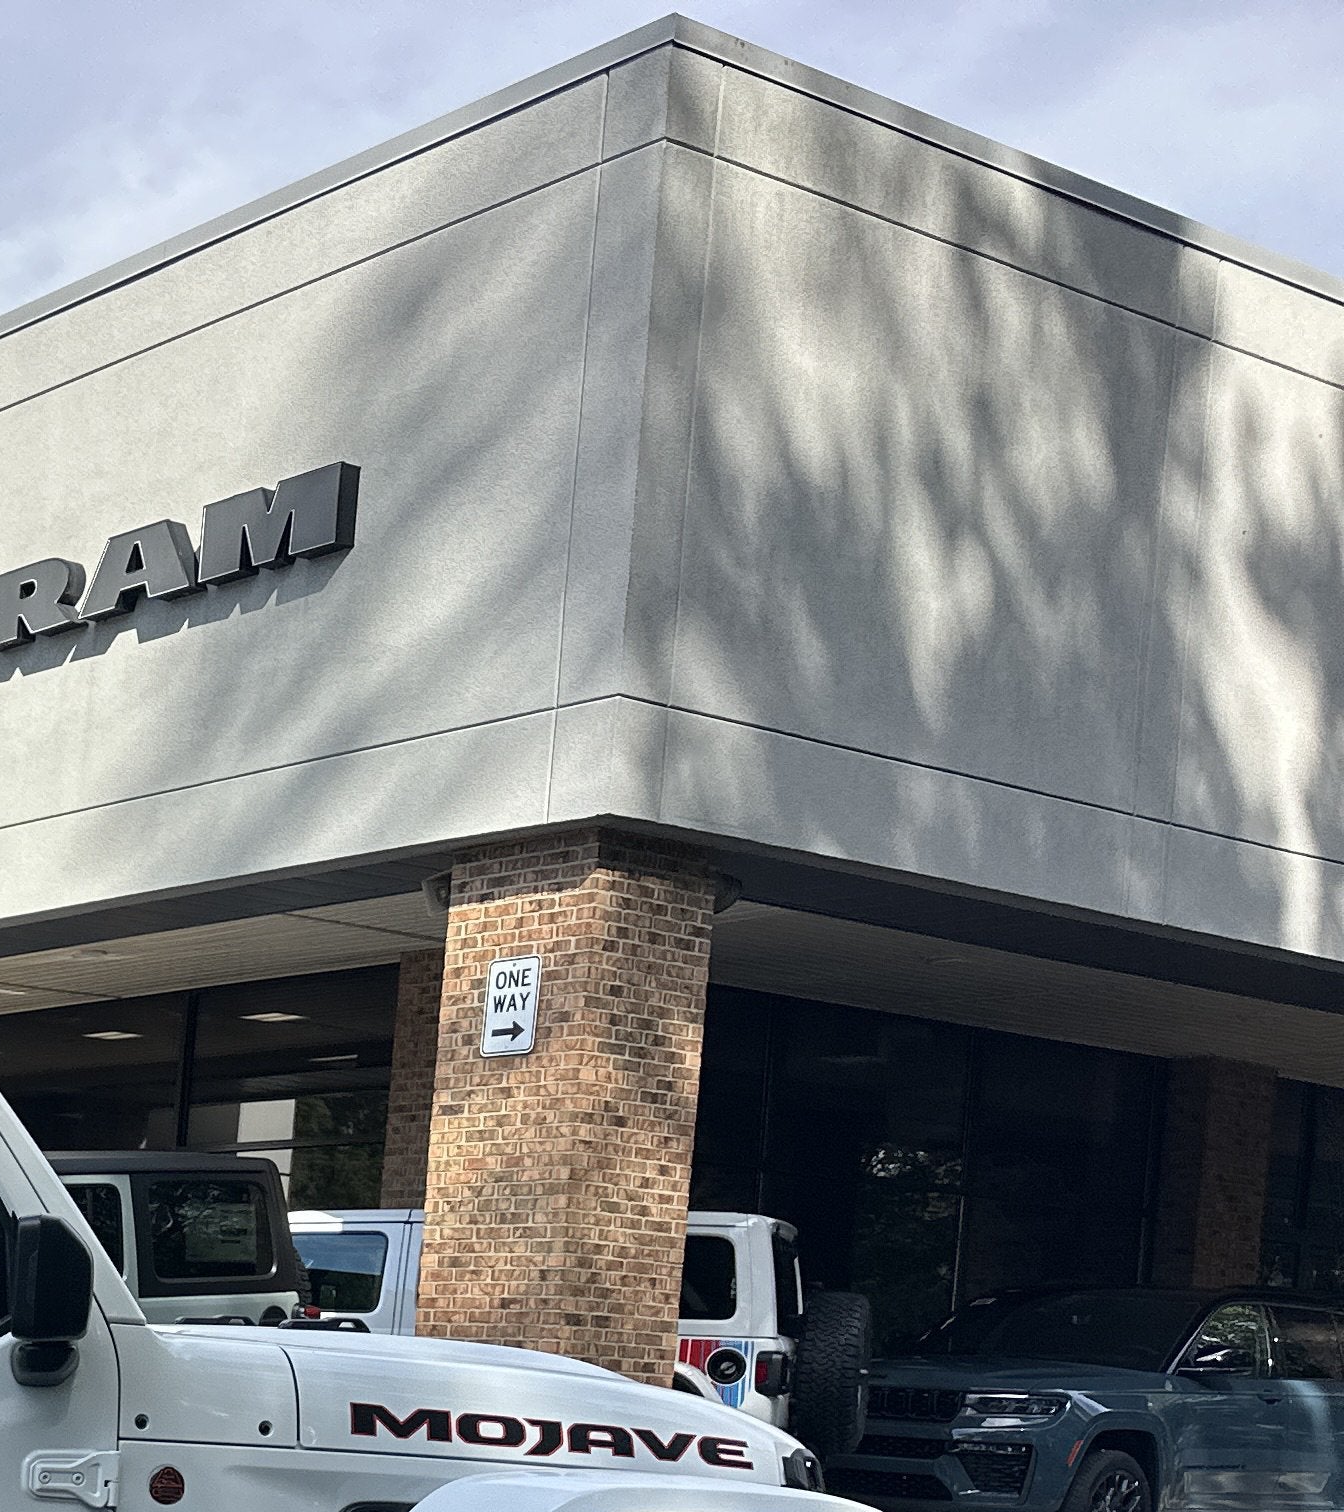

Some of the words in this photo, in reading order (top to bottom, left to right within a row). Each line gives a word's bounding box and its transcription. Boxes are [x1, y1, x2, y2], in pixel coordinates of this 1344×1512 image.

[496, 968, 531, 989] ONE
[493, 992, 530, 1013] WAY
[349, 1402, 754, 1470] MOJAVE
